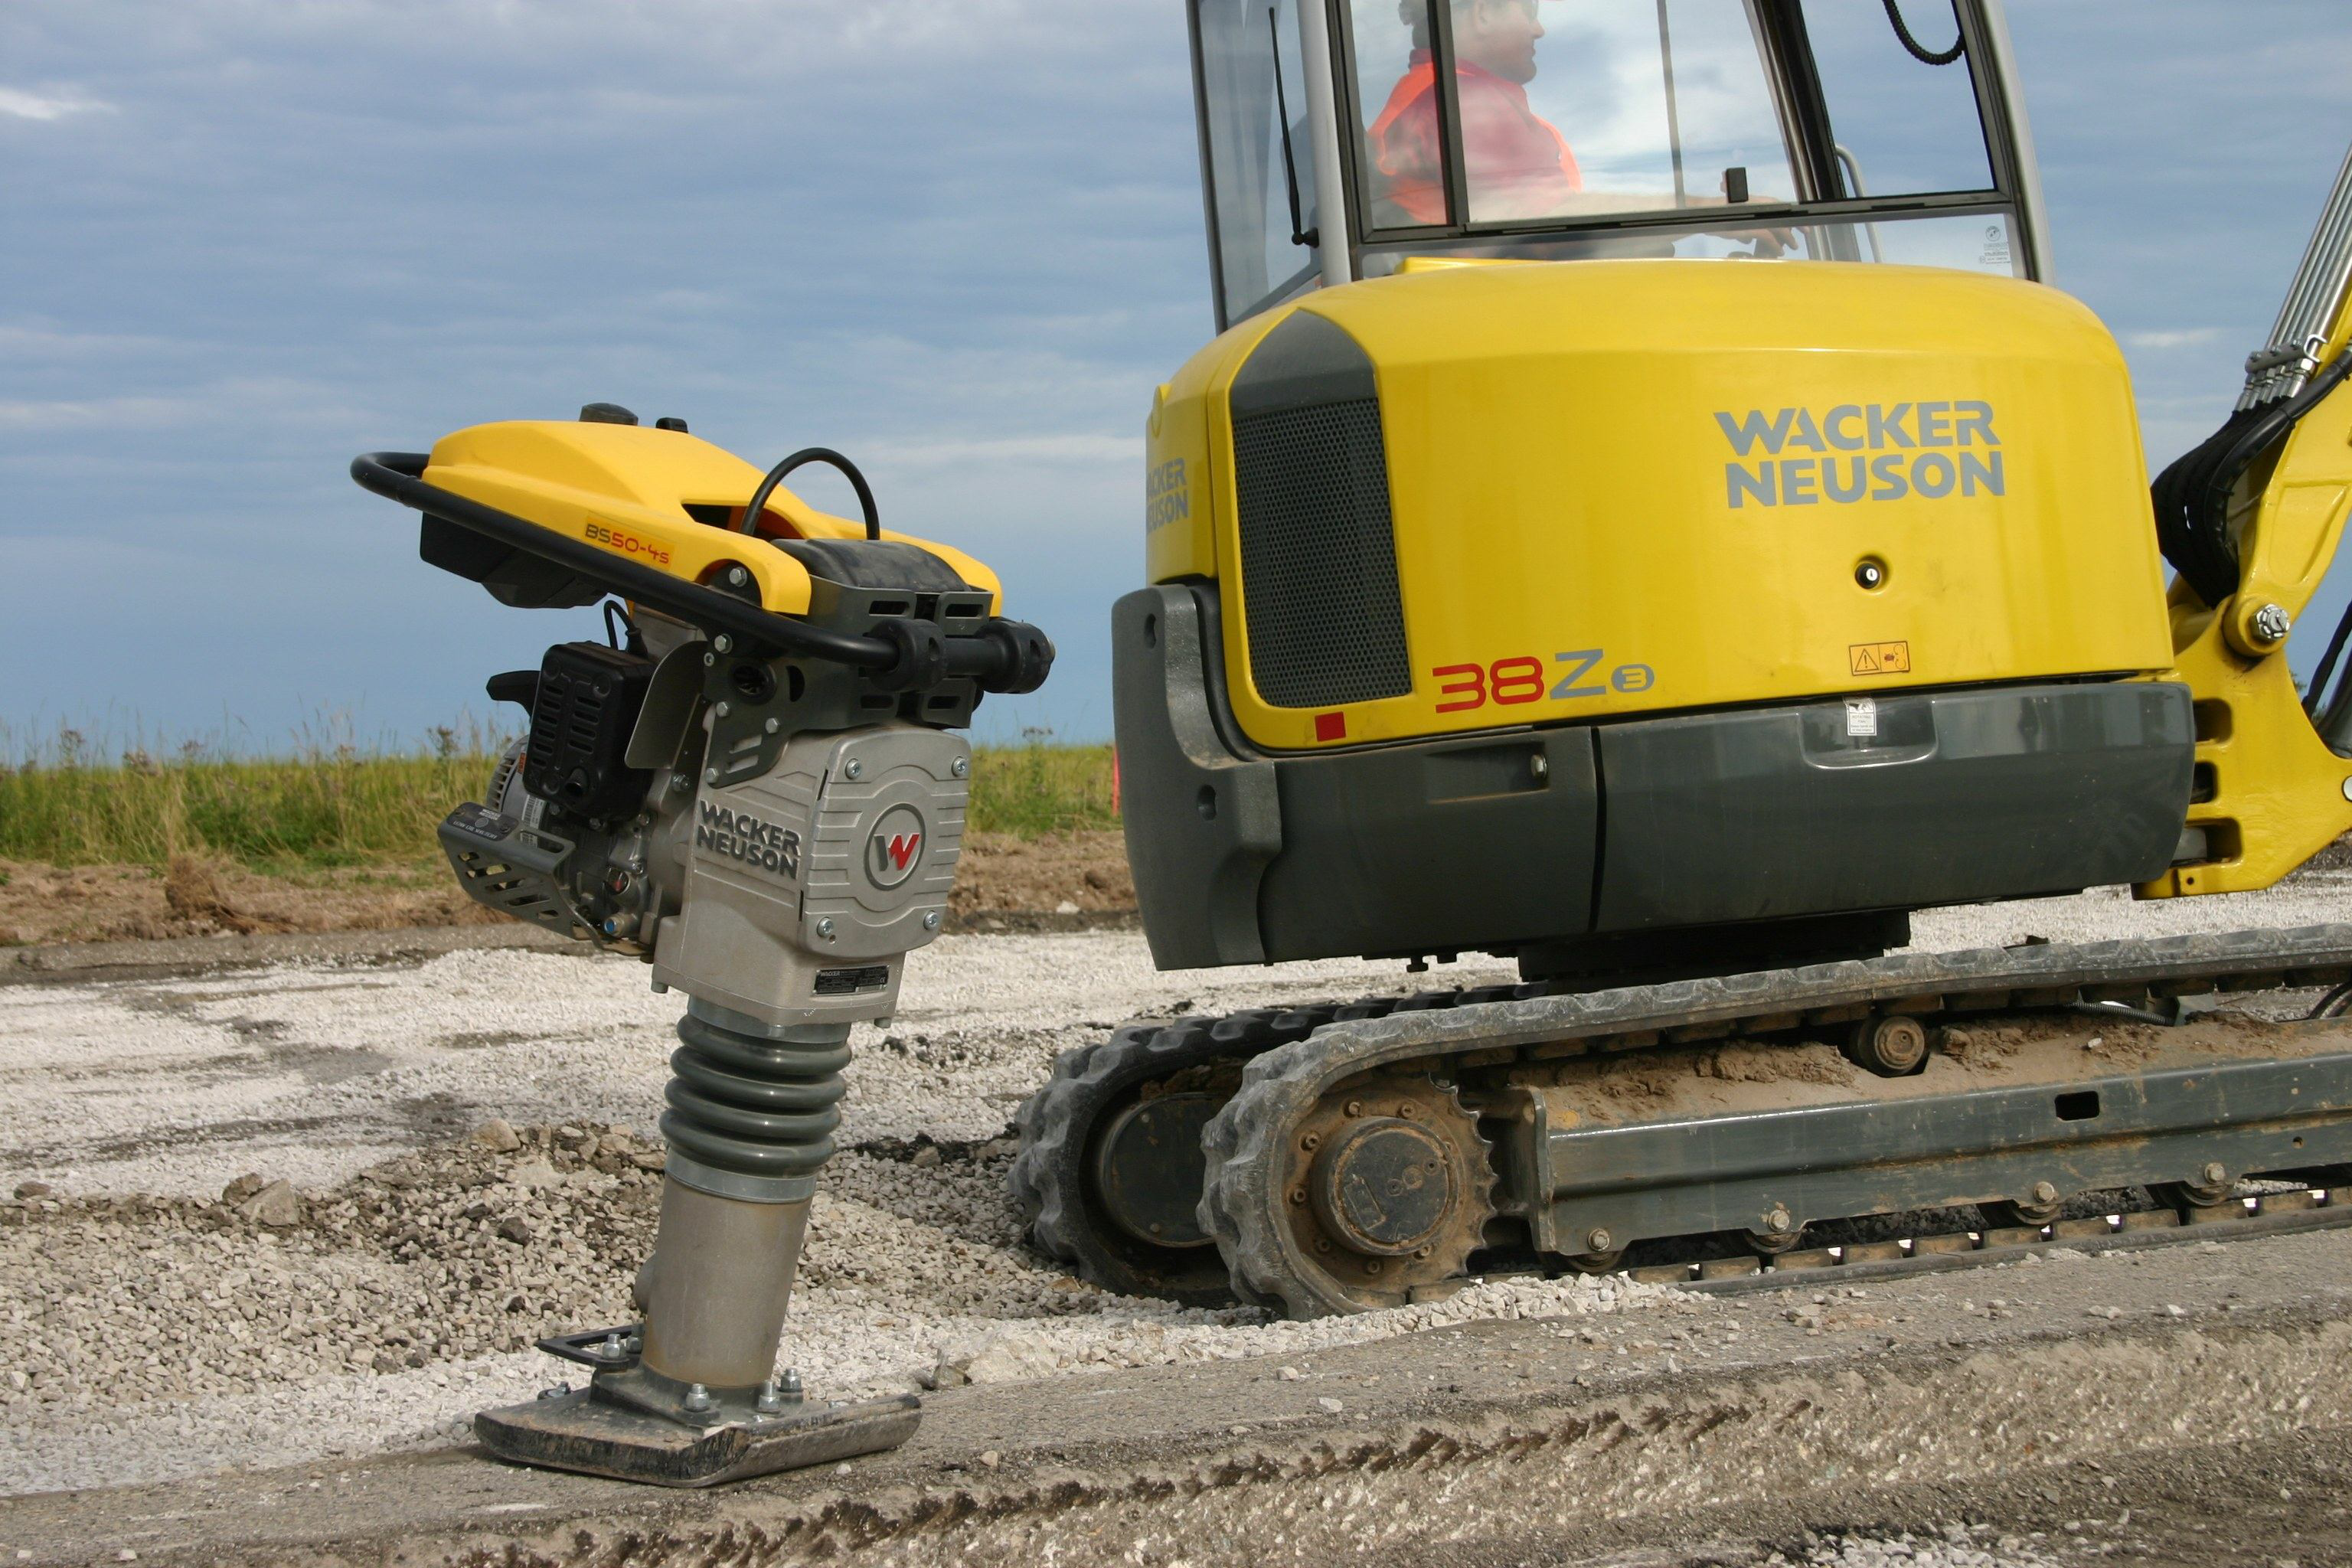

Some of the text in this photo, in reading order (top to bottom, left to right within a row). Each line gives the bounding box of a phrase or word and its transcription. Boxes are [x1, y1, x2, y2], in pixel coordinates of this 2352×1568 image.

[1713, 400, 2001, 456] WACKER
[1725, 451, 2005, 508] NEUSON
[696, 826, 799, 880] NEUSON
[700, 800, 801, 856] WACKER
